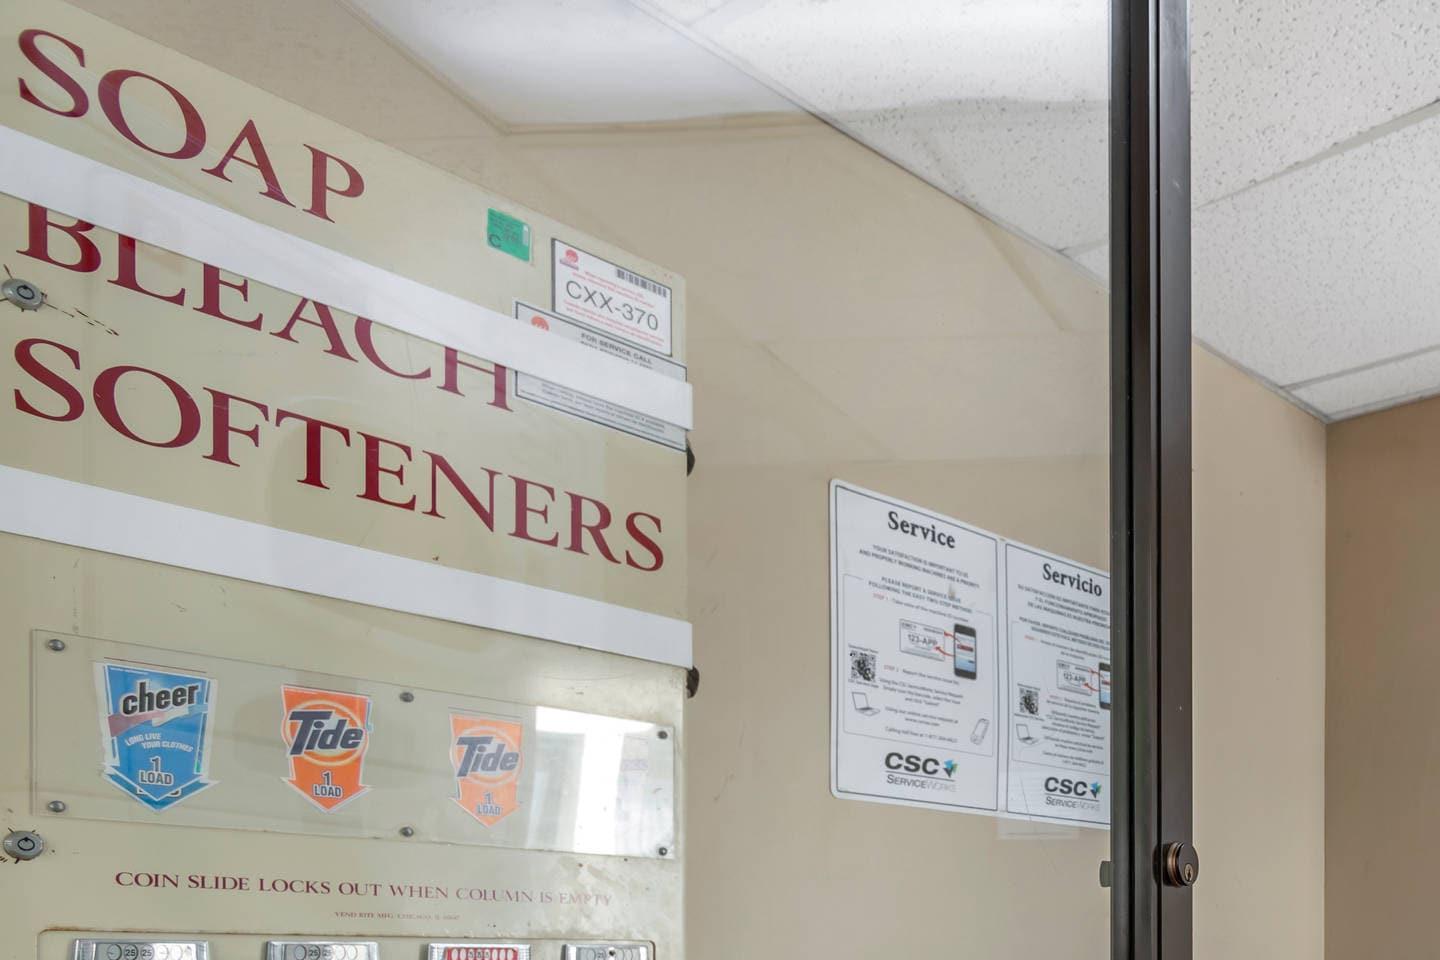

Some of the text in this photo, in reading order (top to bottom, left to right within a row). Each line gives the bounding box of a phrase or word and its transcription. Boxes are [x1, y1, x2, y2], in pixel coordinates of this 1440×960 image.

[17, 28, 366, 224] SOAP
[565, 279, 659, 332] CXX-370
[599, 339, 632, 357] SERVICE
[632, 351, 653, 365] CALL
[13, 336, 667, 573] SOFTENERS
[887, 510, 956, 549] Service
[1042, 562, 1103, 597] Servicio
[122, 681, 200, 716] cheer
[288, 710, 364, 756] Tide
[151, 757, 160, 772] 1
[456, 735, 520, 778] Tide
[884, 751, 941, 776] CSC
[140, 771, 172, 785] LOAD
[314, 785, 342, 797] LOAD
[323, 771, 332, 786] 1
[1043, 776, 1088, 797] CSC
[477, 804, 501, 815] LOAD
[115, 871, 613, 906] COIN SLIDE LOCKS OUT WHEN COLUMN IS EMPTY
